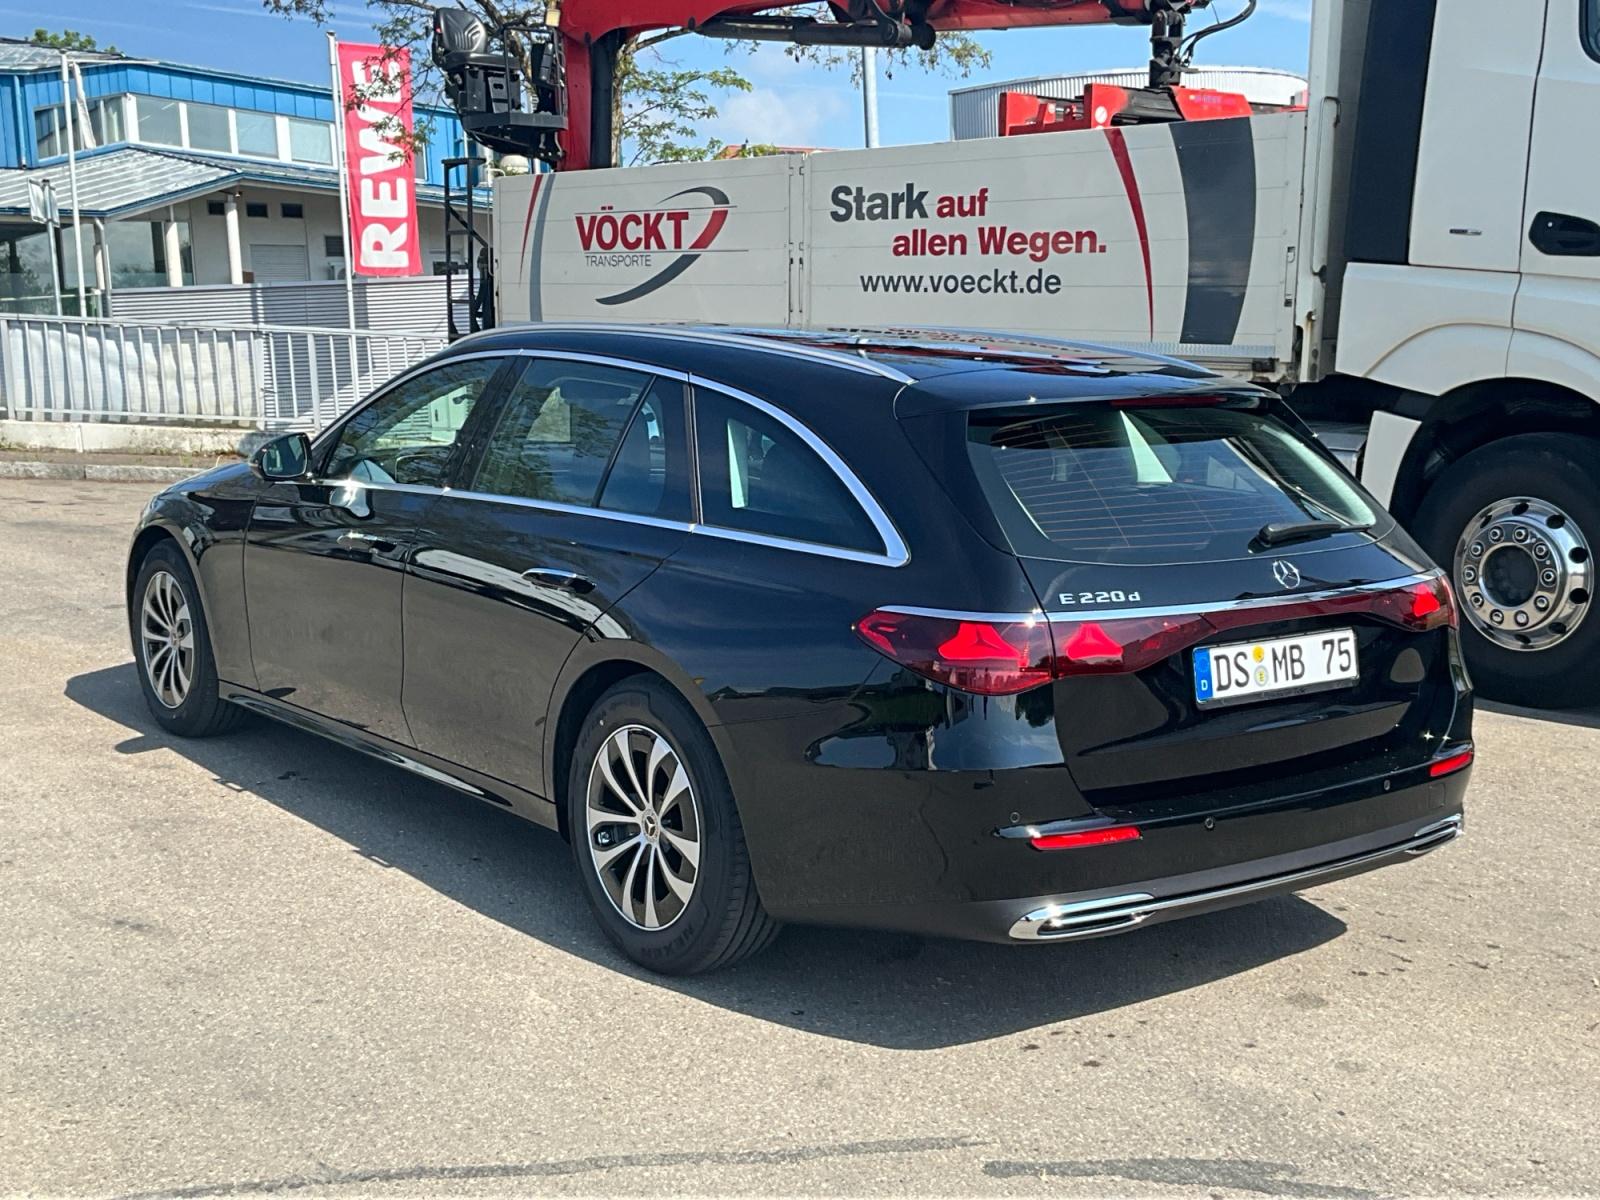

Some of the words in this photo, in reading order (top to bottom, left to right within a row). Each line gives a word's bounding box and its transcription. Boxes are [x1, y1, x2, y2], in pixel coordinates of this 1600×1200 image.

[351, 60, 410, 268] REWE
[830, 183, 929, 222] Stark
[936, 188, 989, 218] auf
[575, 205, 689, 251] VÖCKT
[892, 229, 967, 257] allen
[977, 226, 1107, 262] Wegen.
[585, 254, 652, 267] TRANSPORTE
[860, 268, 1062, 294] www.voeckt.de
[1059, 593, 1076, 604] E
[1078, 590, 1125, 604] 220
[1213, 651, 1250, 692] DS
[1271, 644, 1305, 683] MB
[1322, 637, 1352, 675] 75
